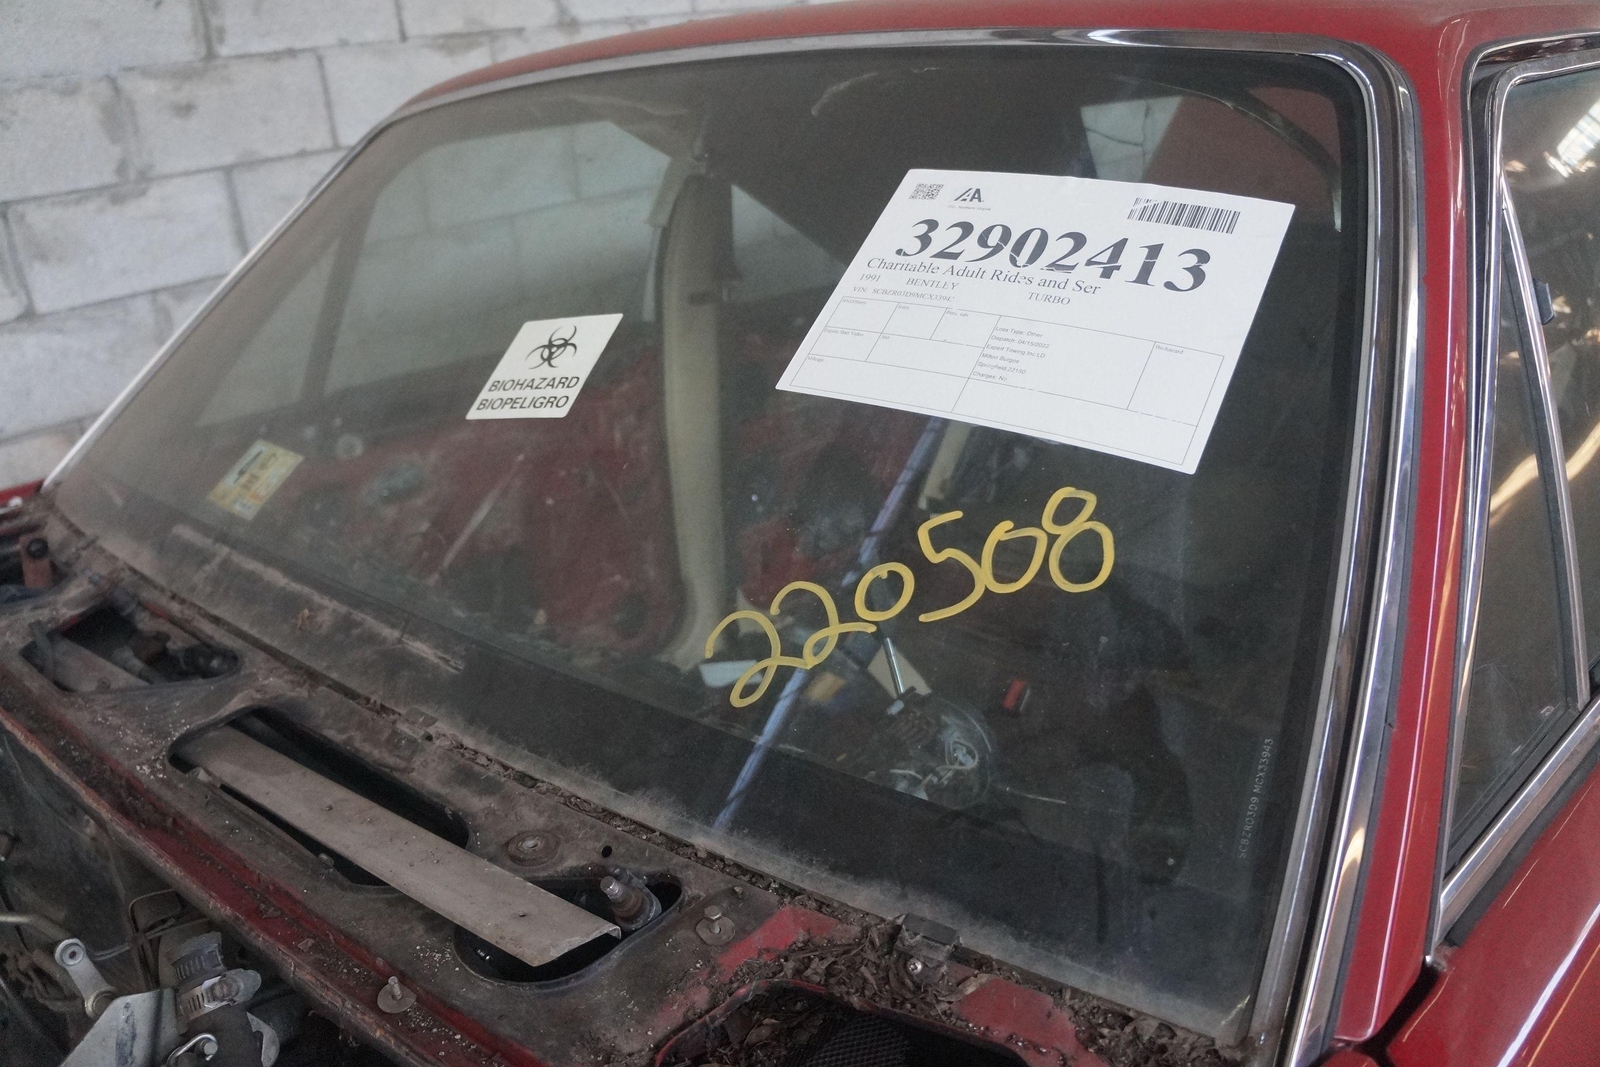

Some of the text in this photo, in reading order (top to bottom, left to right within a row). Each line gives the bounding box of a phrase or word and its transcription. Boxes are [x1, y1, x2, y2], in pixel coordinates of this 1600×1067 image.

[895, 217, 1212, 292] 32902413
[867, 257, 1102, 295] Charitable Adult Rides and Ser
[860, 273, 1071, 306] 1991 BENTLEY TURBO
[1026, 330, 1043, 338] Other
[986, 344, 1005, 352] Expert
[1005, 347, 1026, 356] Towing
[999, 355, 1020, 364] Burgos
[488, 376, 580, 392] BIOHAZARD
[476, 395, 570, 411] BIOPELIGRO
[1253, 738, 1274, 794] MCX33943
